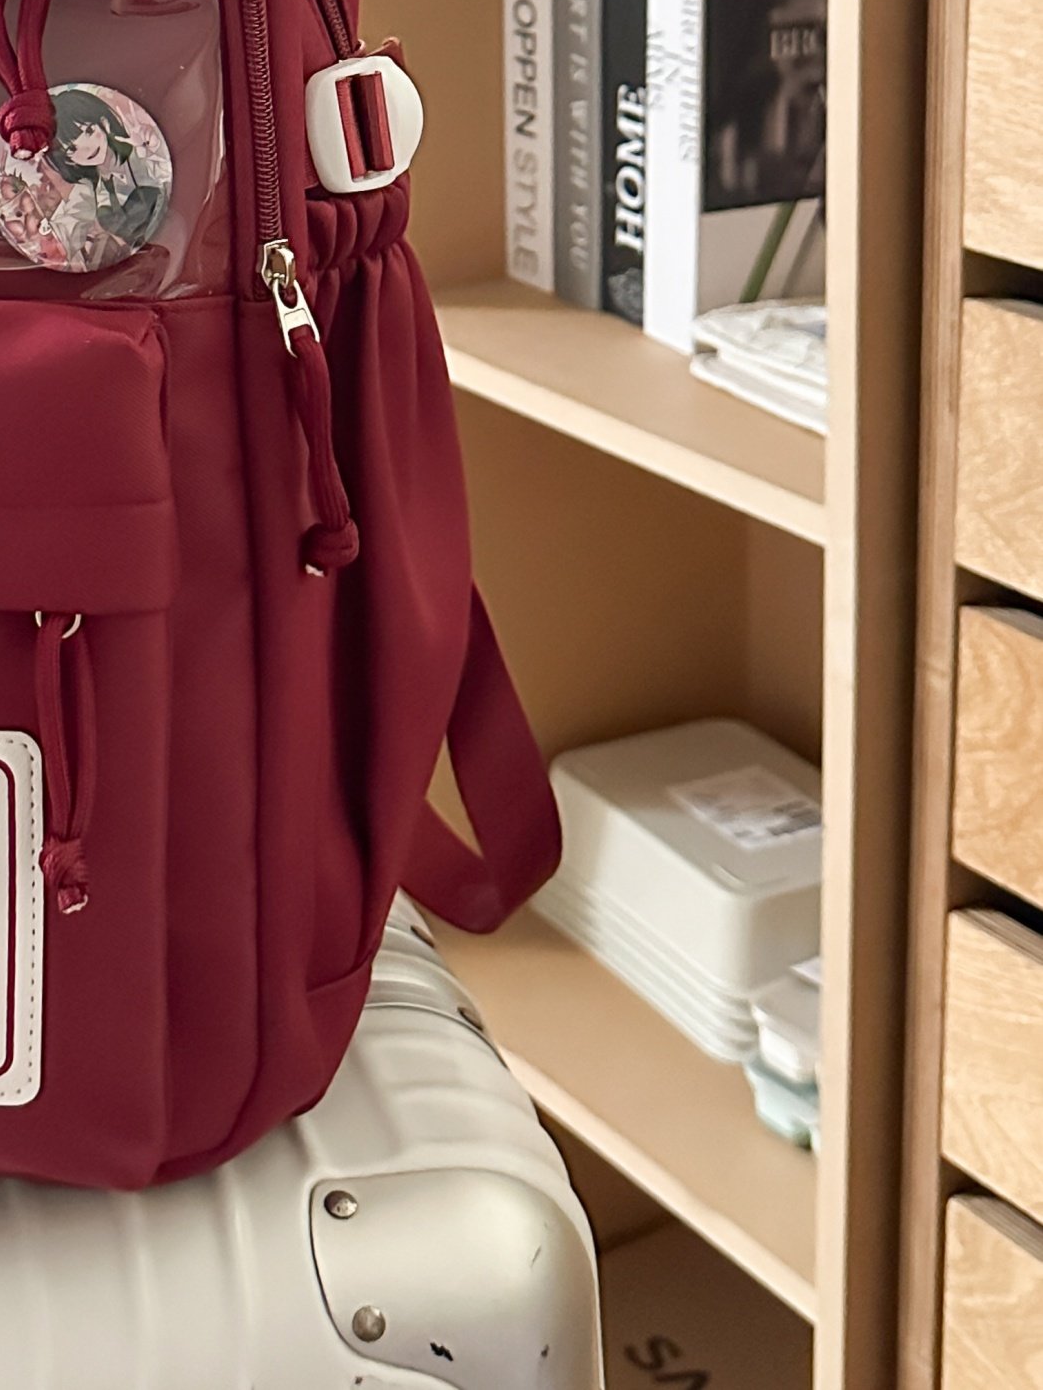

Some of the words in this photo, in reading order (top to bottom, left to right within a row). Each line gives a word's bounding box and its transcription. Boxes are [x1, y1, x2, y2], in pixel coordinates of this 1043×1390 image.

[569, 52, 588, 85] IS
[569, 100, 589, 190] WITH
[615, 84, 647, 252] HOME
[513, 147, 539, 277] STYLE
[569, 205, 589, 271] YOU
